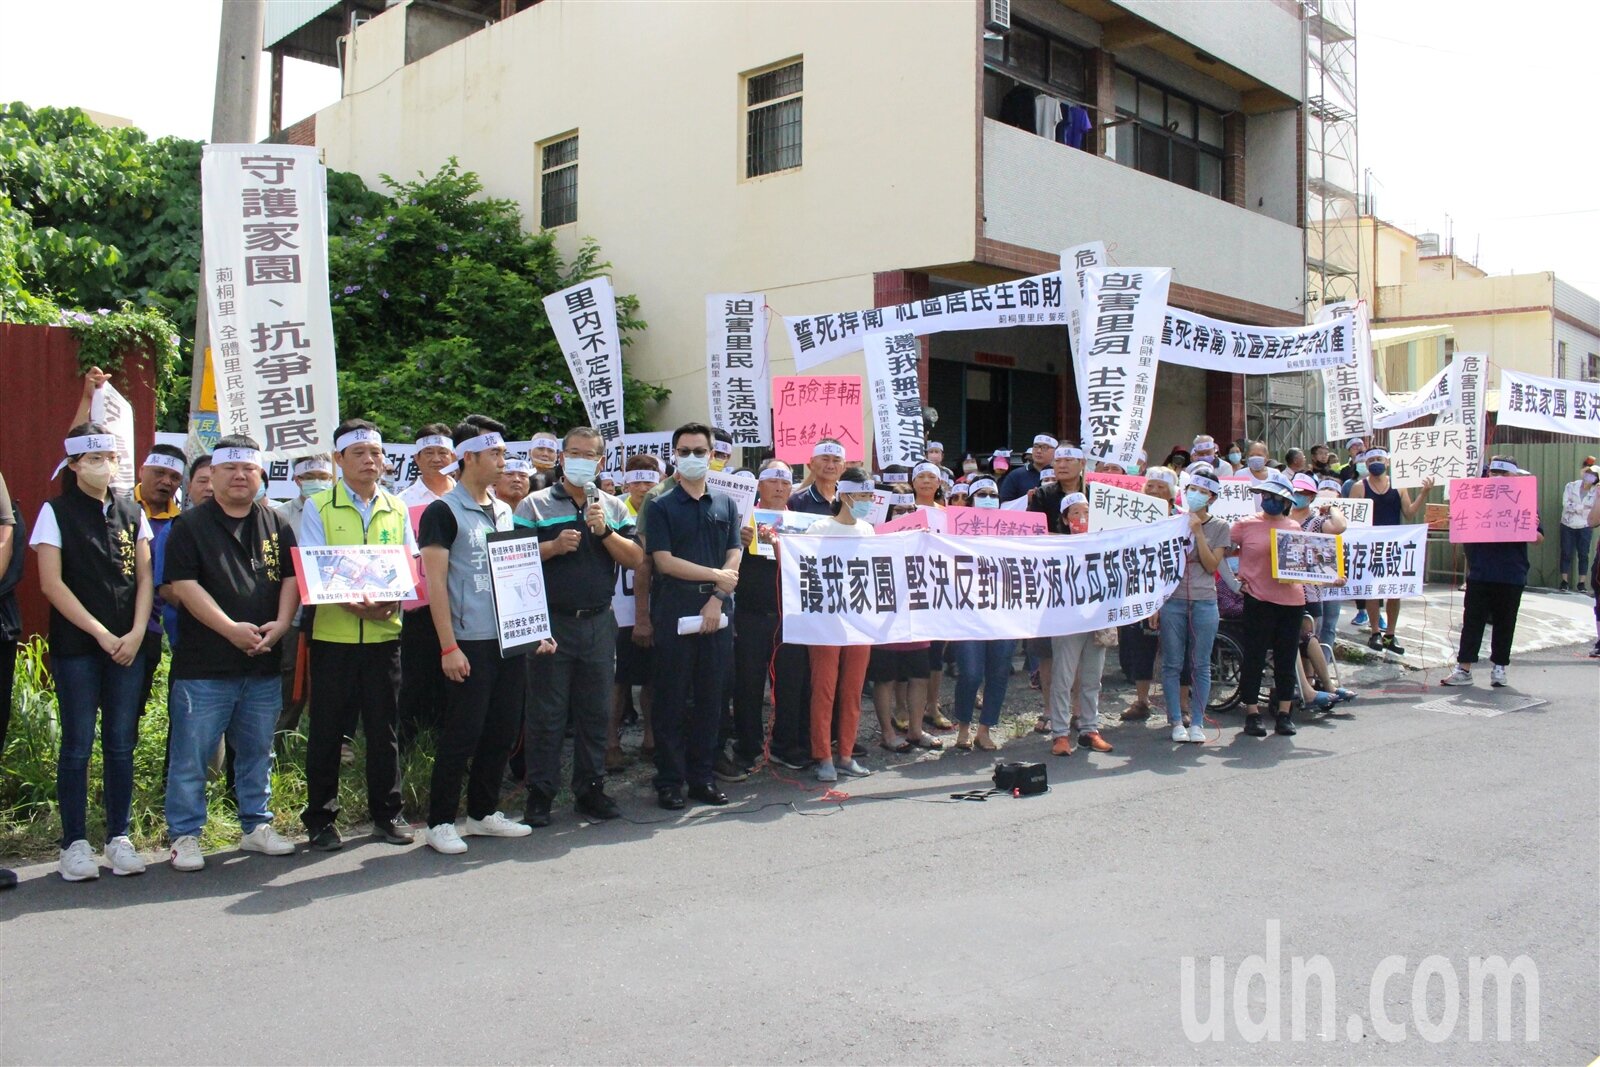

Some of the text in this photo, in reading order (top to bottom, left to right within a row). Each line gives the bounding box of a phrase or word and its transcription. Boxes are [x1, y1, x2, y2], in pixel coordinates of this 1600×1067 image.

[215, 267, 237, 317] 莿桐里
[241, 154, 319, 452] 守護家園、抗爭到底
[793, 275, 1061, 353] 誓死捍衛 社區居民生命財
[725, 299, 754, 369] 迫害里民
[1161, 315, 1345, 360] 誓死捍衛 社區居民生命財產
[726, 376, 761, 444] 生活恐慌
[778, 378, 862, 415] 危險車輛
[884, 332, 926, 462] 還我無憂生活
[1508, 382, 1567, 418] 護我家園
[777, 421, 858, 448] 拒絕出入
[1394, 430, 1462, 453] 危害里民
[707, 477, 732, 489] 2018台南
[1395, 455, 1465, 479] 生命安全
[1094, 488, 1164, 524] 訴求安全
[1452, 482, 1522, 505] 危害居民
[1453, 508, 1532, 533] 生活恐惶
[799, 536, 1188, 615] 護我家園 堅決反對順彰液化瓦斯儲存場設
